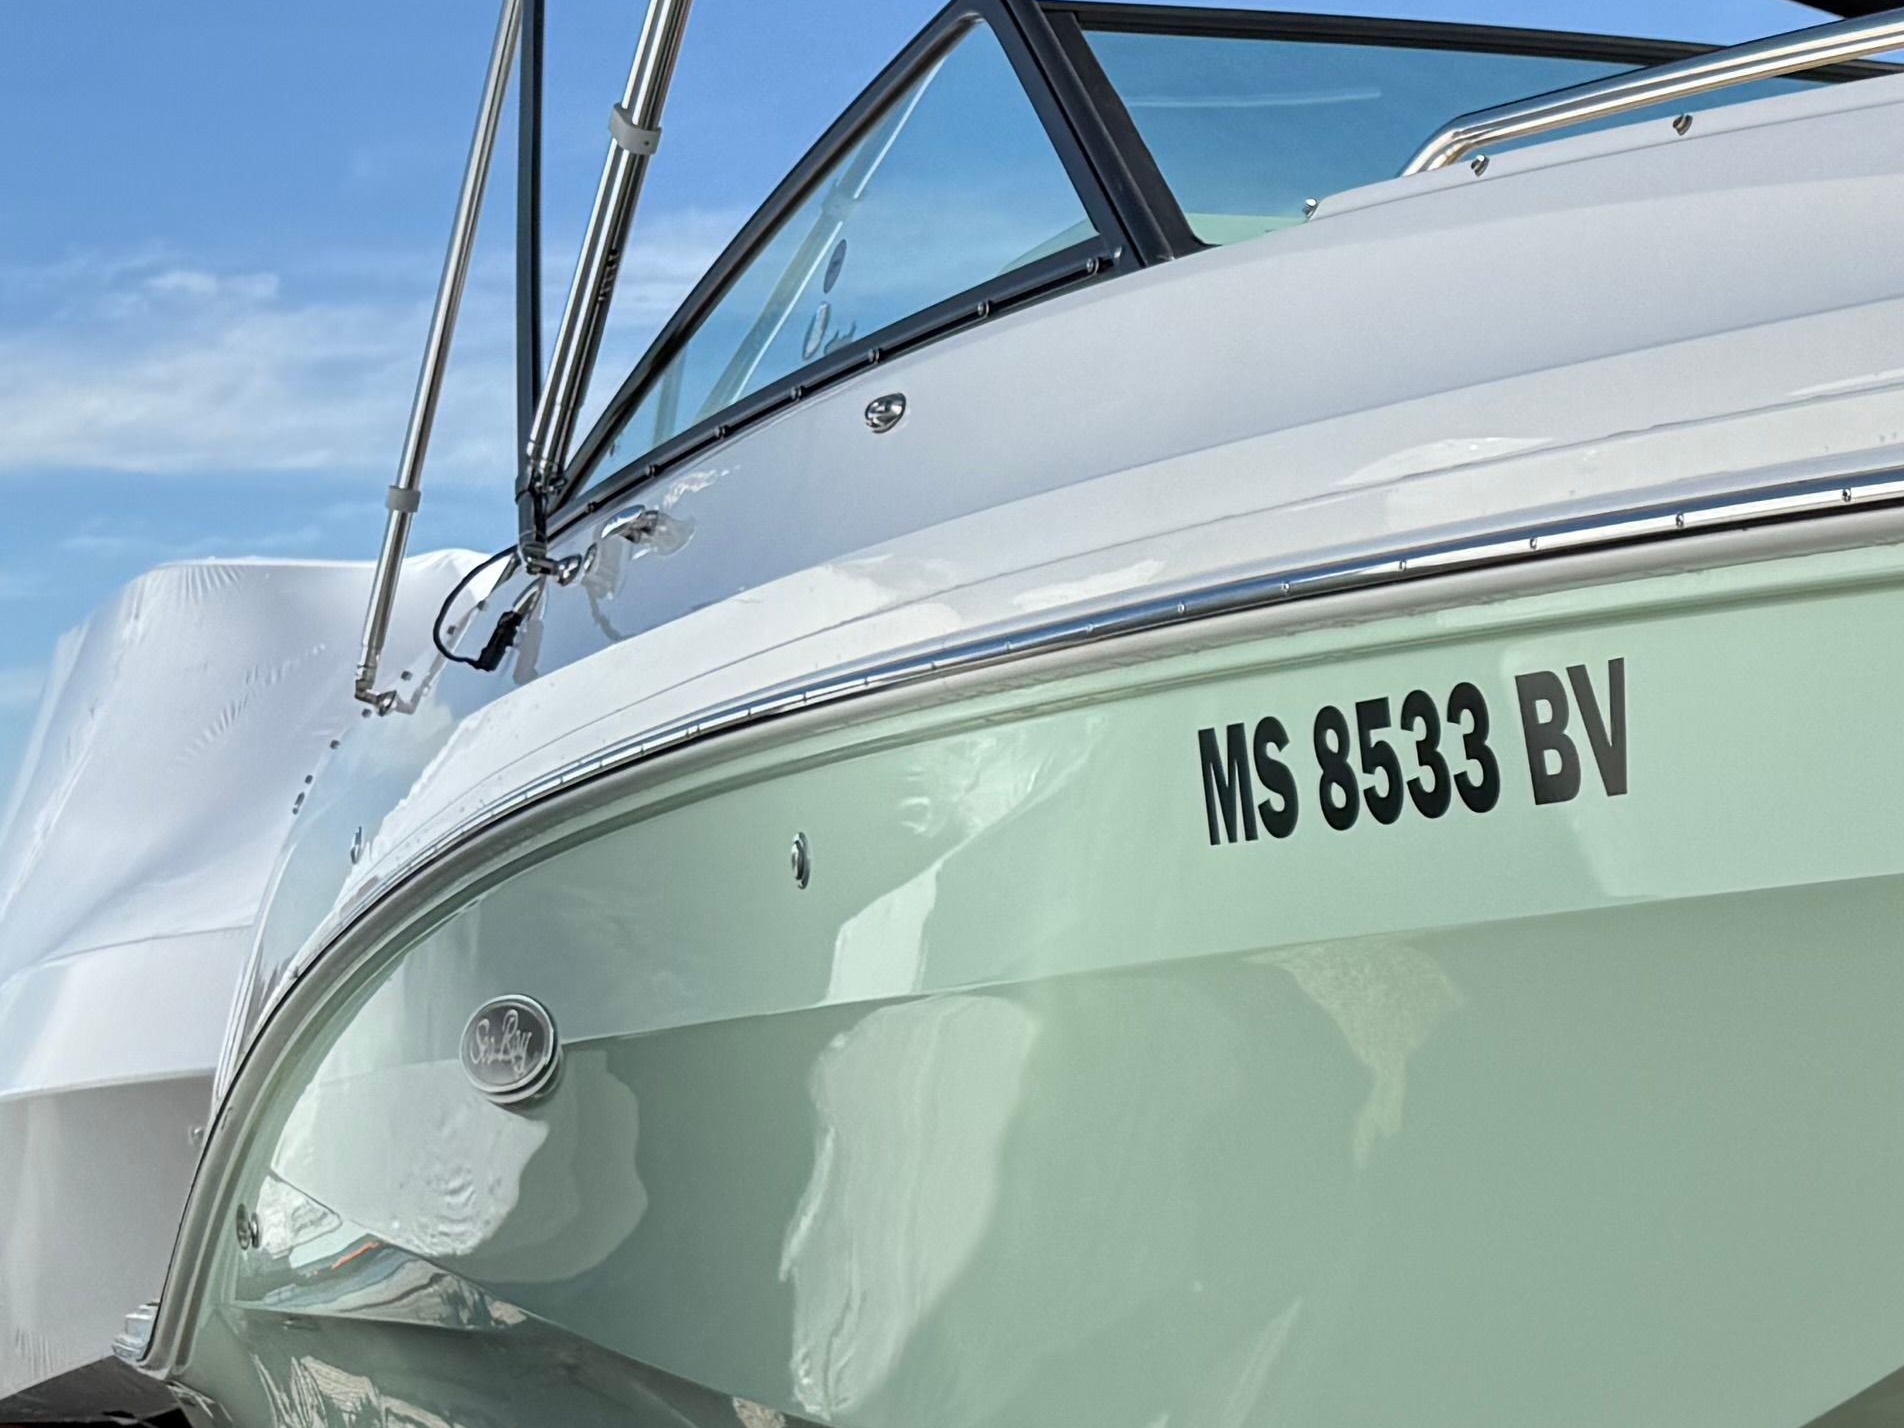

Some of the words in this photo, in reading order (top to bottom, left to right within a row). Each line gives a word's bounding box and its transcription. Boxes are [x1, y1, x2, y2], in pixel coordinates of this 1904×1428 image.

[1197, 715, 1299, 846] MS
[1312, 681, 1501, 832] 8533
[1515, 656, 1628, 807] BV
